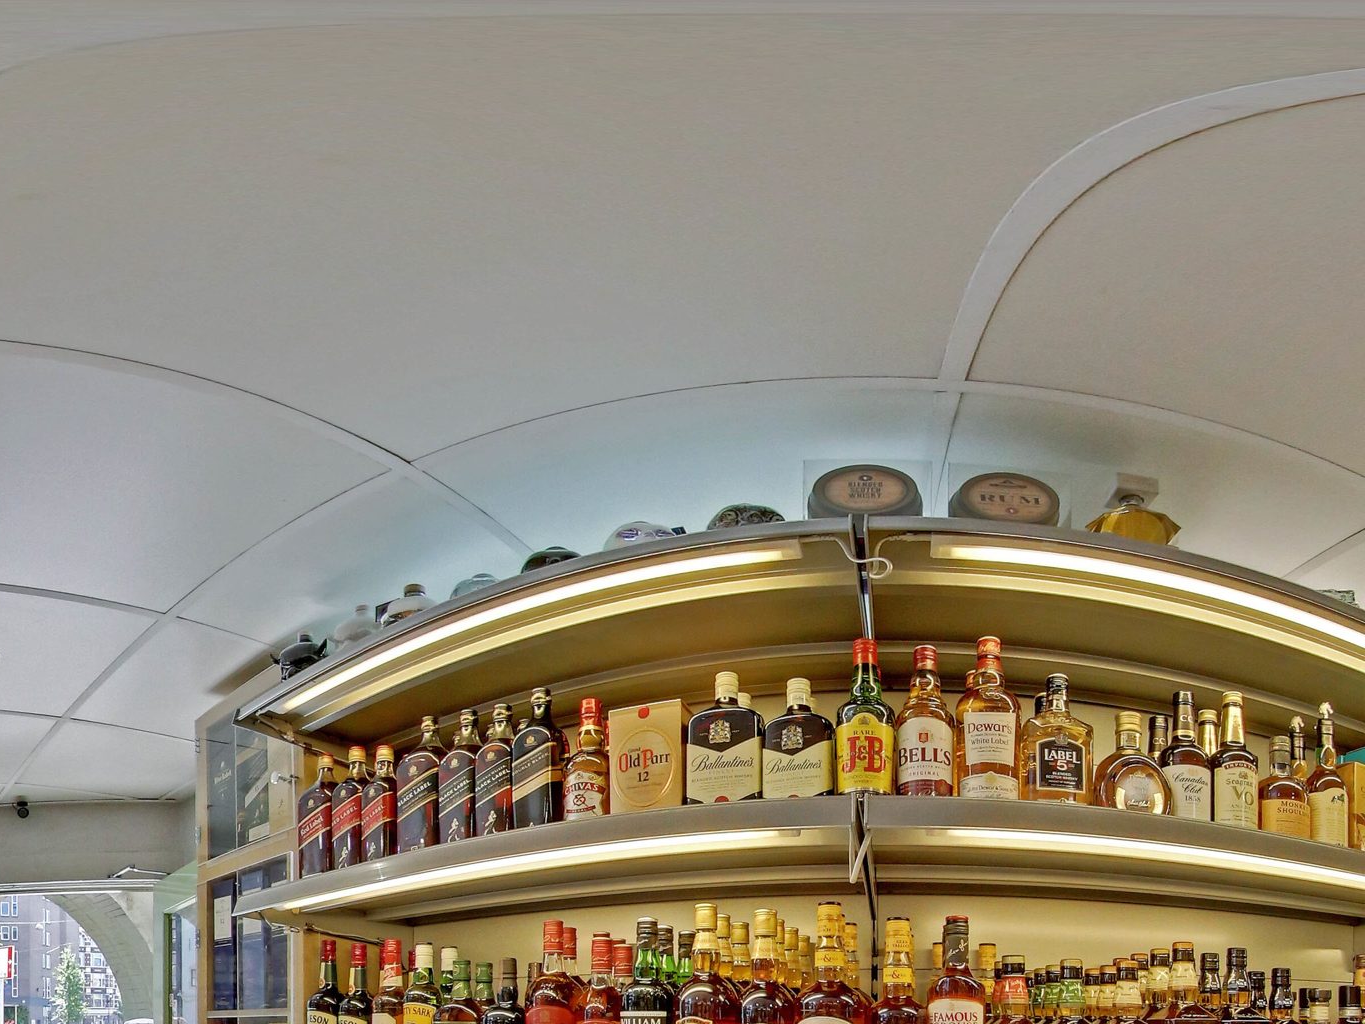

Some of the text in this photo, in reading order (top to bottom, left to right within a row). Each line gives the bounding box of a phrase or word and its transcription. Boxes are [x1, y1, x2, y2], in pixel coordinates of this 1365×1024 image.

[980, 494, 1041, 504] RUM
[967, 723, 1012, 735] Dewar's
[619, 749, 670, 773] Old Parr
[691, 752, 755, 772] Ballantine's
[843, 736, 886, 773] J&B
[899, 747, 951, 767] BELL'S
[1044, 749, 1081, 764] LABEL
[765, 758, 822, 776] Ballantine's
[1056, 760, 1067, 771] 5
[491, 767, 510, 783] LABEL
[637, 771, 649, 782] 12
[1172, 772, 1208, 786] Canadian
[413, 781, 432, 797] LABEL
[565, 783, 599, 795] CHIVAS
[1232, 786, 1254, 806] VO
[414, 1005, 432, 1018] SARK
[933, 1012, 978, 1022] FAMOUS
